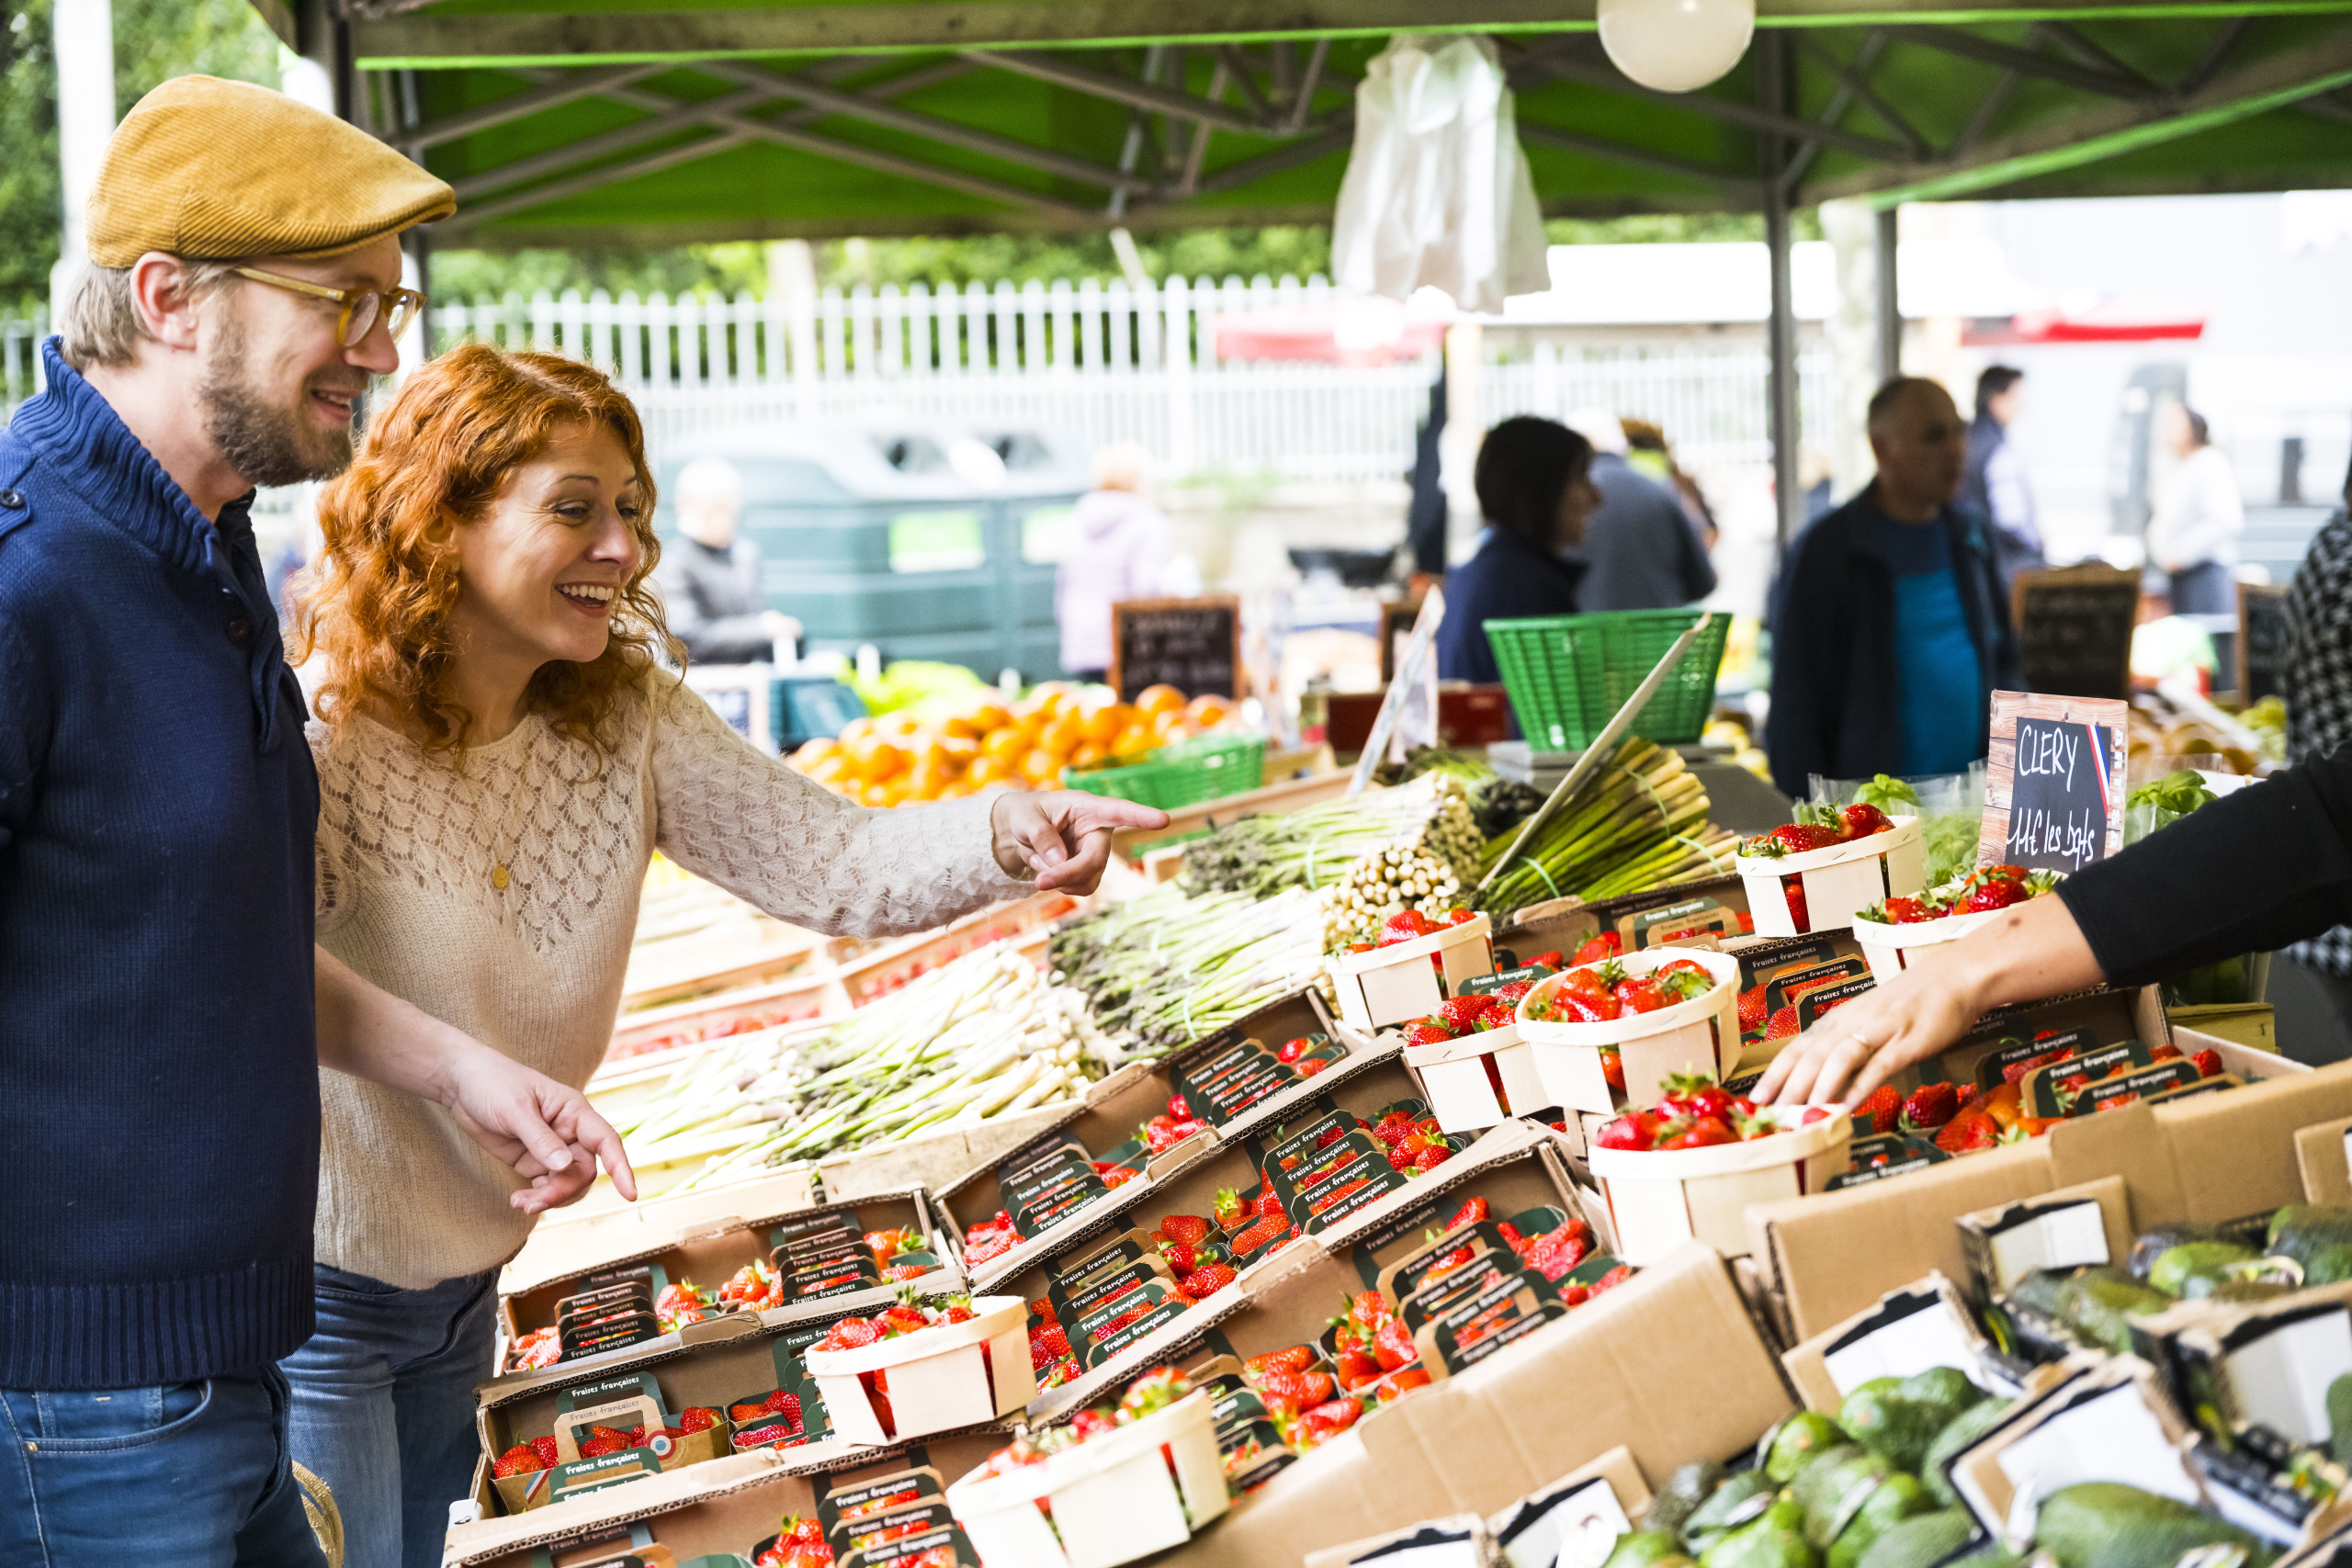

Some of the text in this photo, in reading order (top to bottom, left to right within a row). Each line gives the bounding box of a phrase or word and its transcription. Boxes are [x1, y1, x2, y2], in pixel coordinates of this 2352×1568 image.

[2018, 724, 2078, 793] CLERY
[2109, 728, 2123, 858] ARTISA
[2043, 809, 2062, 854] les
[1752, 946, 1815, 967] Fraises françaises
[1781, 964, 1846, 986] Fraises françaises
[1815, 980, 1878, 1002] Fraises française
[1256, 1101, 1316, 1138] Fraises françaises
[1276, 1118, 1337, 1157] Fraises françaises
[1287, 1141, 1350, 1181] Fraises françaises
[1305, 1160, 1369, 1202] Fraises françaises
[1030, 1181, 1087, 1213] Fraises françaises
[1322, 1180, 1388, 1224] Fraises françaises
[1038, 1195, 1097, 1230] Fraises françaises
[793, 1247, 854, 1267] Fraises françaises
[1061, 1248, 1121, 1286] Fraises françaises
[796, 1263, 857, 1282] Fraises françaises
[572, 1287, 633, 1307] Fraises françaises
[792, 1283, 855, 1304] Fraises françaises
[1072, 1270, 1136, 1309] Fraises françaises
[572, 1301, 634, 1322] Fraises françaises
[1081, 1292, 1147, 1331] Fraises françaises
[575, 1320, 639, 1339] Fraises françaises
[786, 1335, 812, 1346] Fraises
[1103, 1310, 1170, 1352] Fraises françaises
[571, 1336, 635, 1358] Fraises françaises
[571, 1377, 639, 1397] Fraises françaises
[571, 1401, 639, 1421] Fraises françaises
[566, 1453, 639, 1475] Fraises françaises
